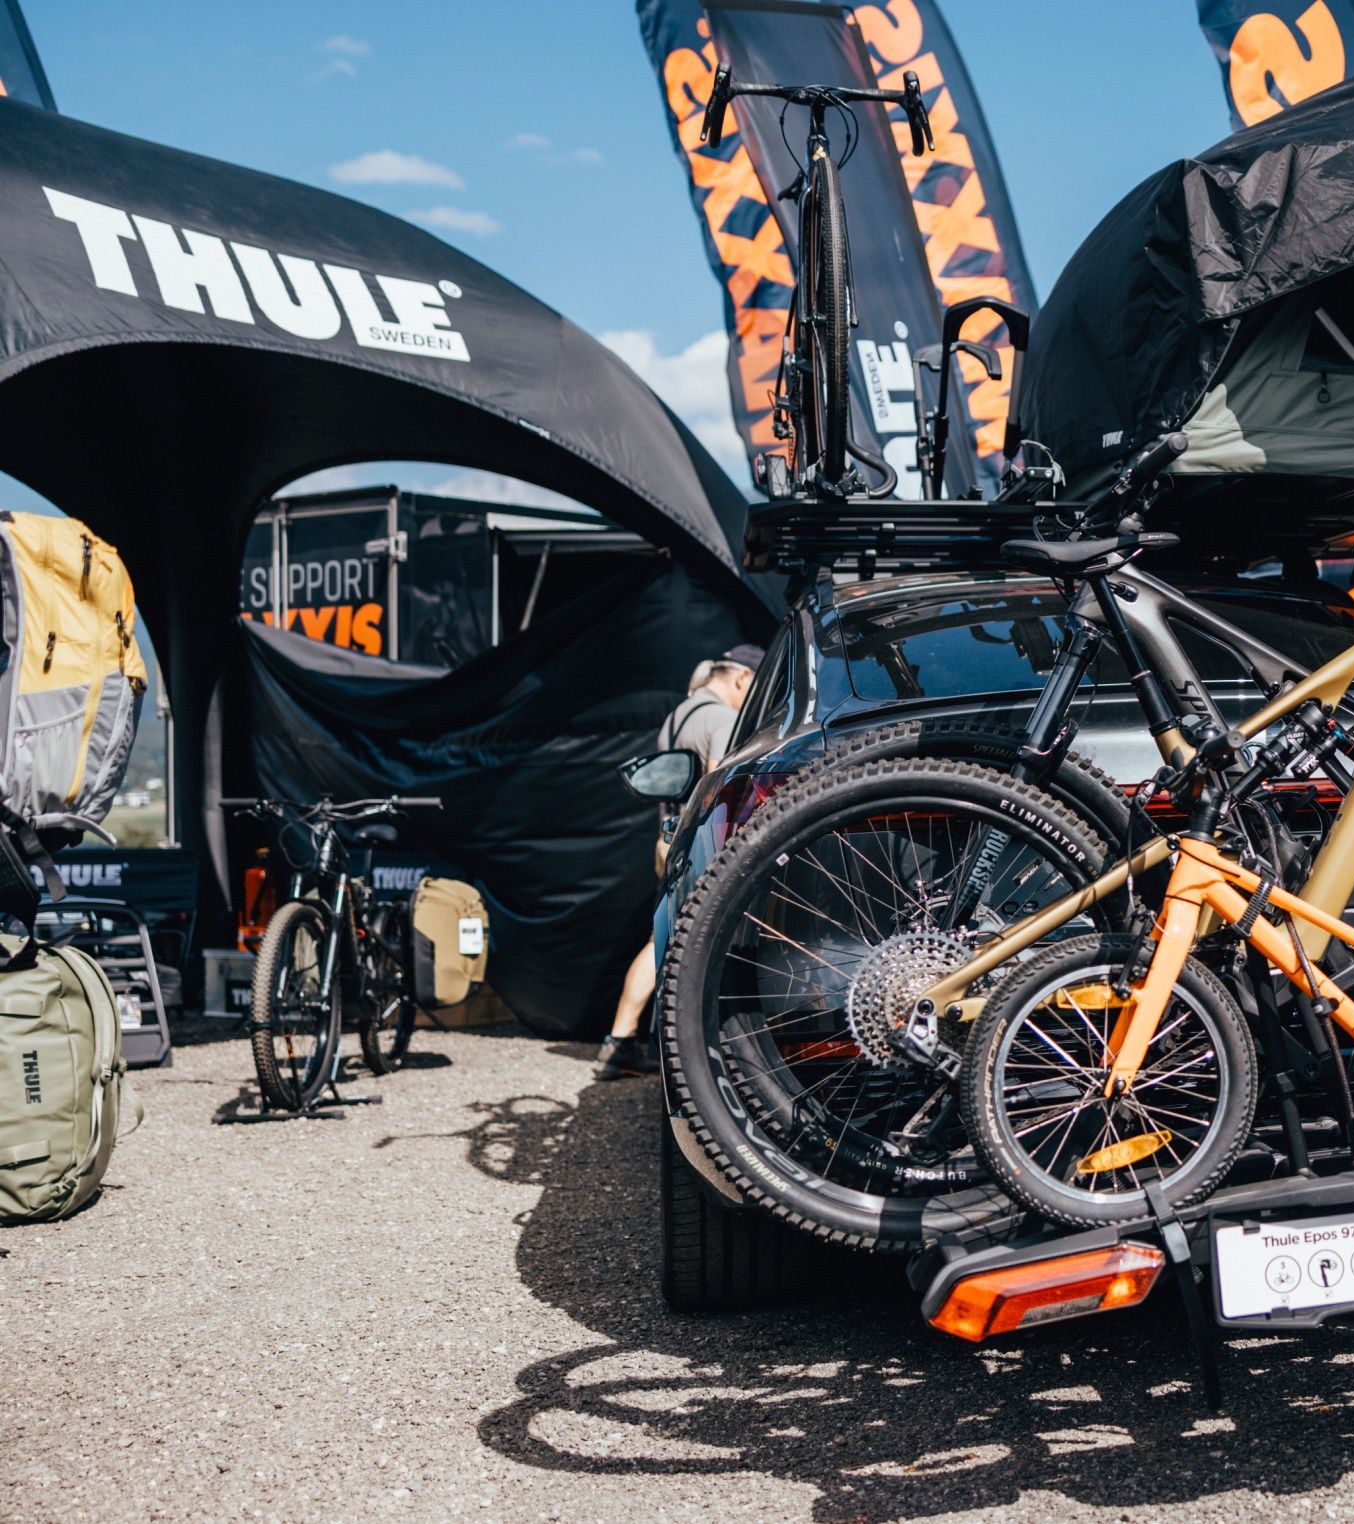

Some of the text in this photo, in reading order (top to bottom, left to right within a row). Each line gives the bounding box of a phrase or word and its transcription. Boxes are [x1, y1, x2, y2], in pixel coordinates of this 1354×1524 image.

[42, 186, 471, 362] THULE
[369, 326, 452, 351] SWEDEN
[1000, 799, 1086, 863] ELIMINATOR
[22, 1050, 42, 1104] THULE
[985, 1018, 1008, 1143] PATHFINDER
[1262, 1232, 1300, 1249] Thule
[1304, 1226, 1338, 1244] Epos
